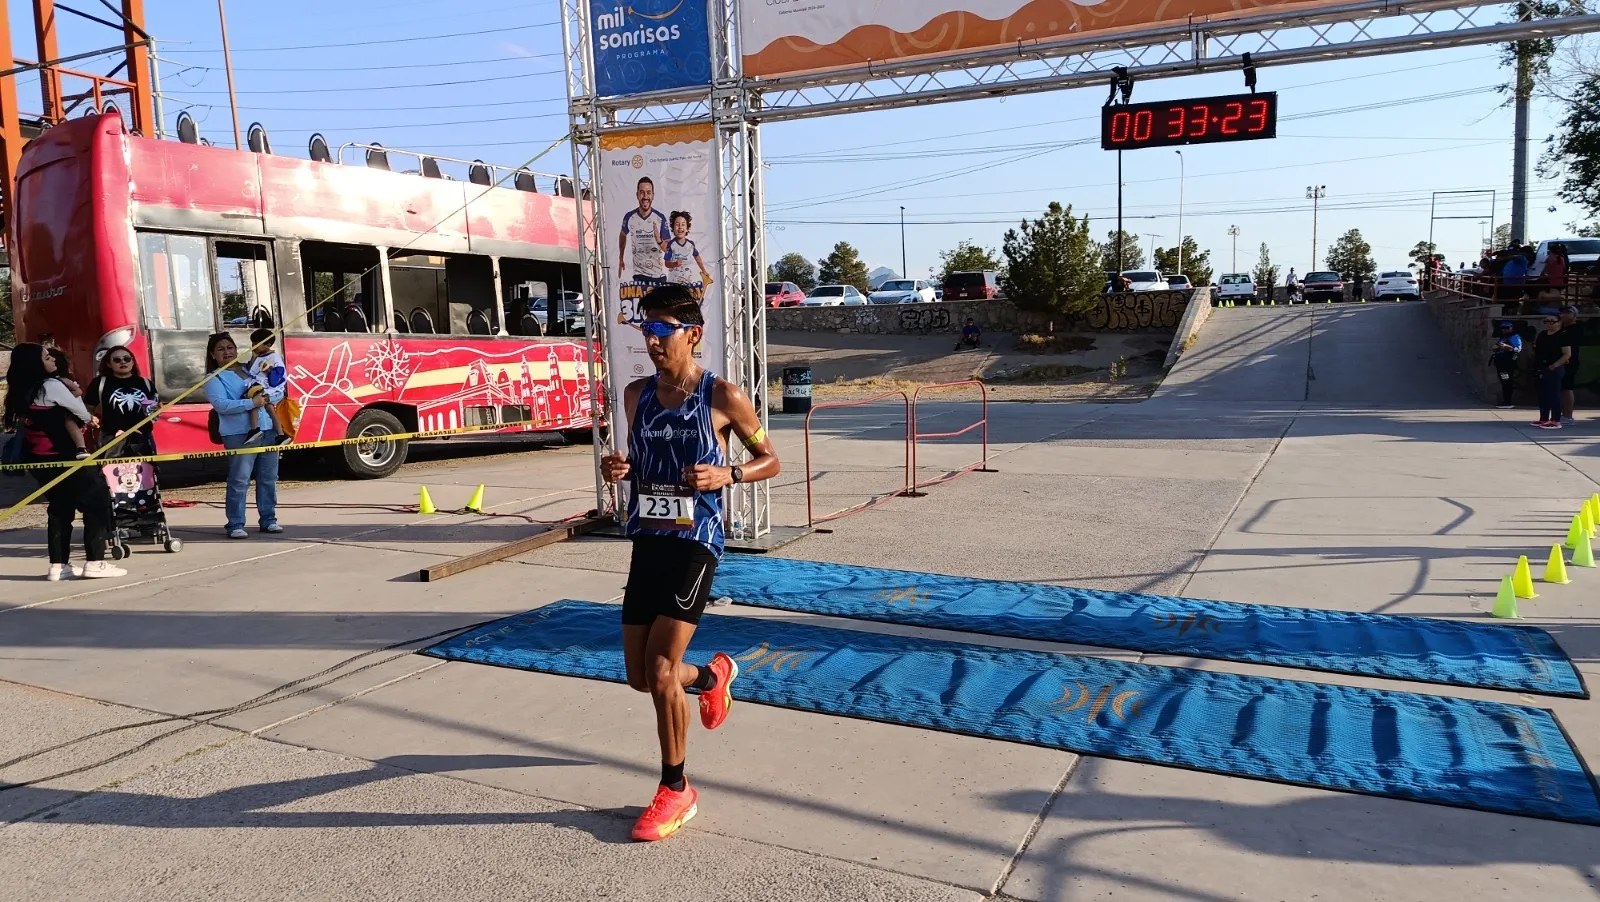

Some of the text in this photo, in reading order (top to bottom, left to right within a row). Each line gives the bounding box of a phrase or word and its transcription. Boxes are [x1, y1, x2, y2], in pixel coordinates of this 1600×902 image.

[598, 7, 625, 30] mil
[600, 24, 680, 50] sonrisas
[617, 49, 665, 60] PROGRAMA
[1112, 110, 1152, 142] 00
[612, 159, 630, 167] Rotary
[620, 285, 643, 299] UNA
[646, 497, 682, 517] 231
